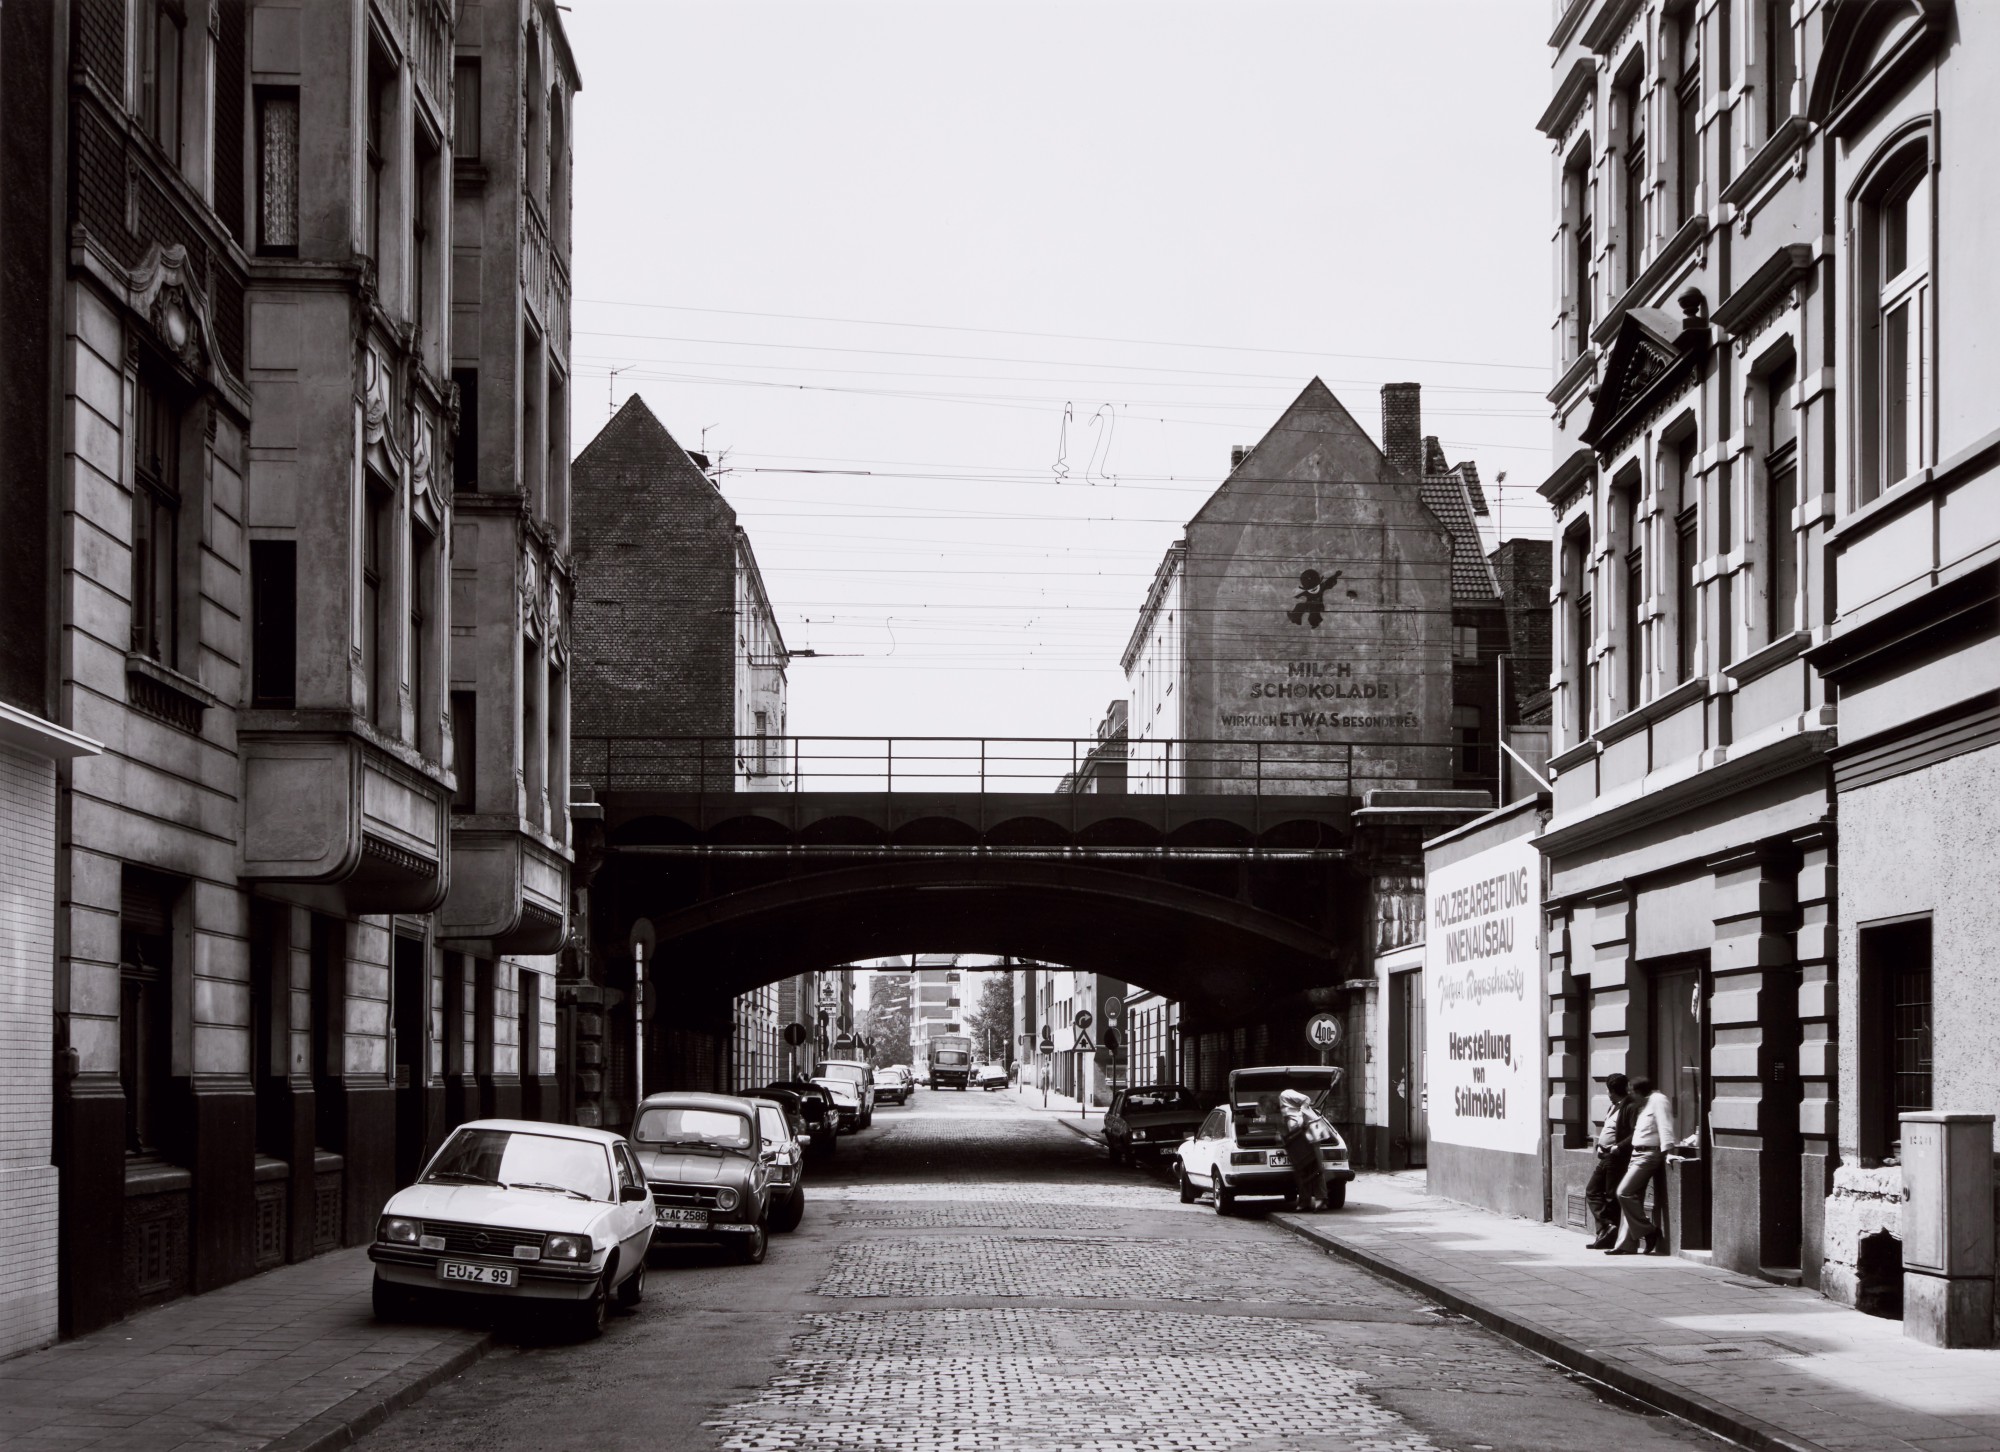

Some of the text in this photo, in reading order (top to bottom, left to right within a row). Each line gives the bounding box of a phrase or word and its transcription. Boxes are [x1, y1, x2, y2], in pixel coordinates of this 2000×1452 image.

[1288, 663, 1351, 678] MILCH
[1221, 712, 1418, 728] WIRKLICH ETWAS BESONDERES
[1434, 866, 1528, 929] HOLZBEARBEITUNG
[1446, 916, 1514, 966] INNENAUSBAU
[1449, 1029, 1511, 1066] Herstellung
[1472, 1067, 1485, 1083] von
[1455, 1085, 1506, 1120] Stilmöbel
[683, 1210, 707, 1221] 2586
[491, 1269, 508, 1283] 99
